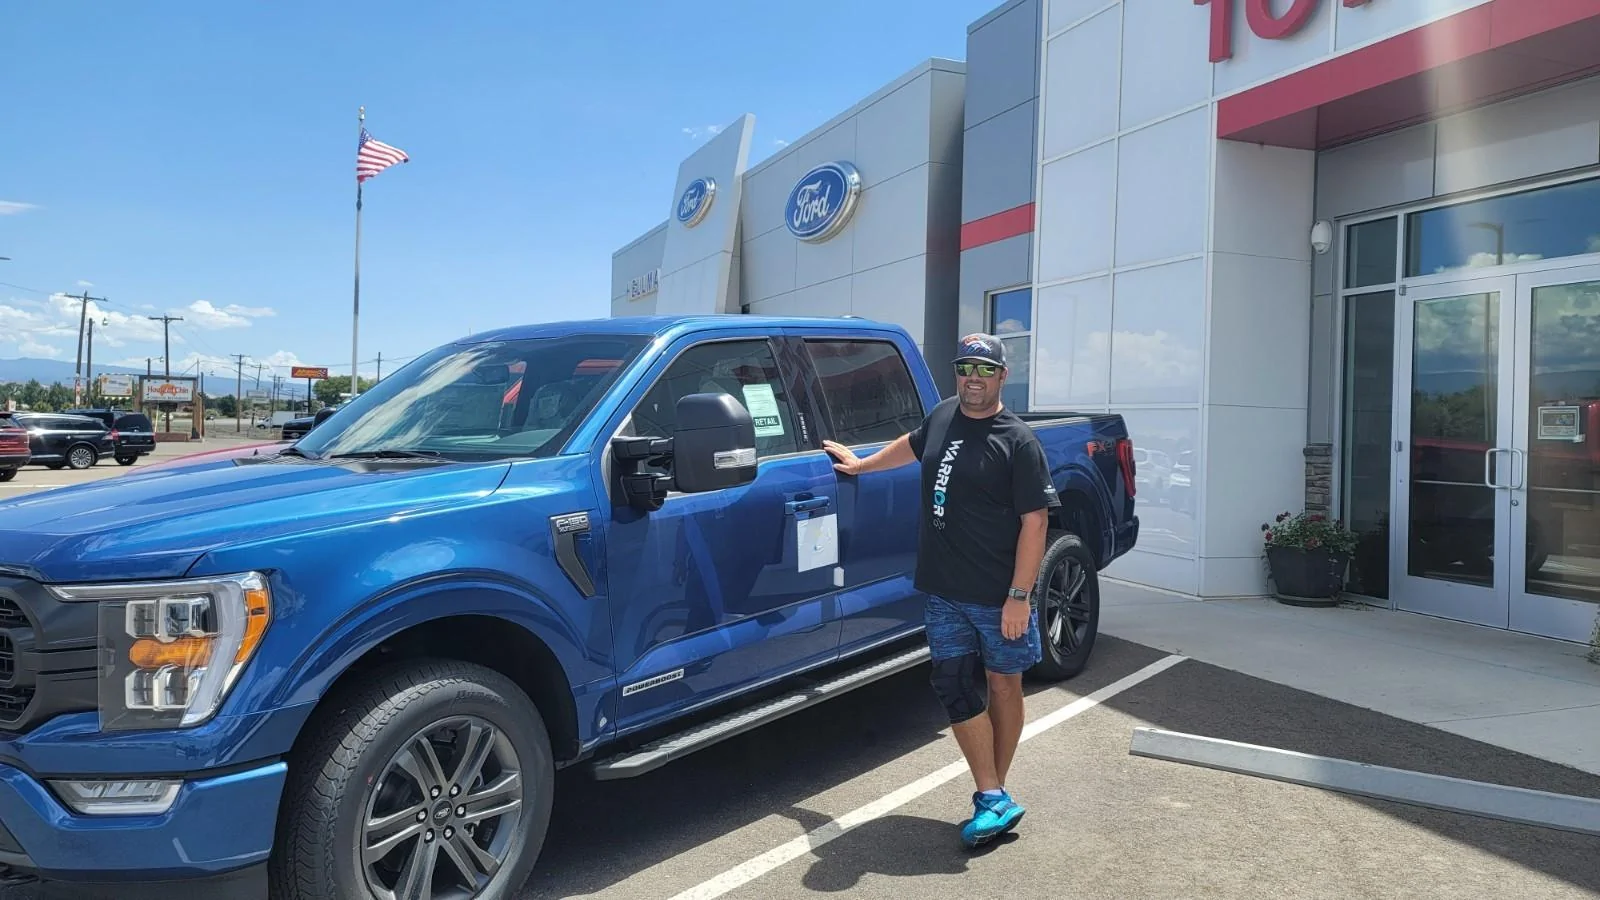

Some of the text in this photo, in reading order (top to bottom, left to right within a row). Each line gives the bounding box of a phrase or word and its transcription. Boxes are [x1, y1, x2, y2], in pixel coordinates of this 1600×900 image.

[680, 186, 700, 217] Ford
[793, 180, 832, 228] Ford
[754, 417, 778, 426] RETAIL
[933, 439, 964, 517] WARRIOR
[625, 670, 683, 694] POWERBOOST
